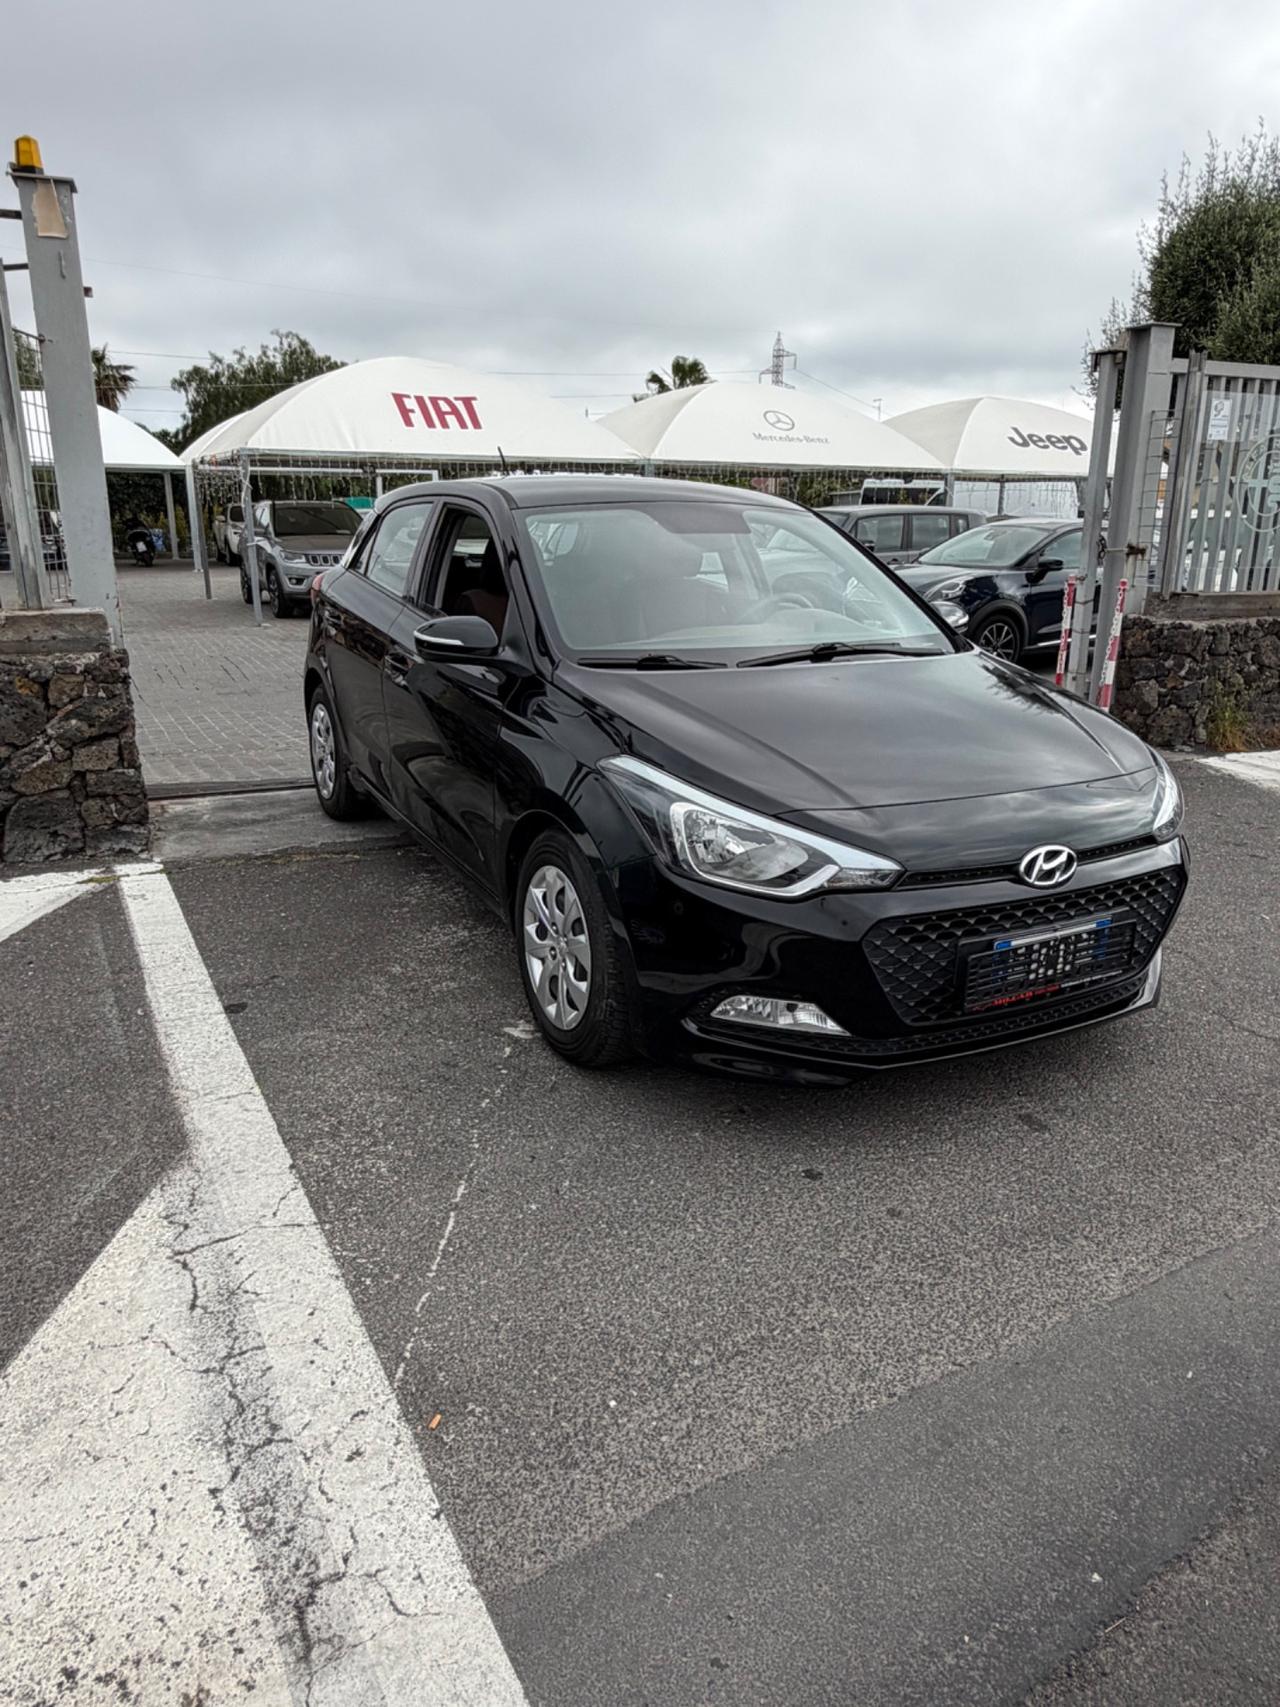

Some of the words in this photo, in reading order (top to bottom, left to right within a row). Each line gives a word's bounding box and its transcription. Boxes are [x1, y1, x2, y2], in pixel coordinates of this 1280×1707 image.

[391, 392, 482, 430] FIAT
[752, 431, 830, 444] Mercedes-Benz
[1007, 426, 1088, 456] Jeep
